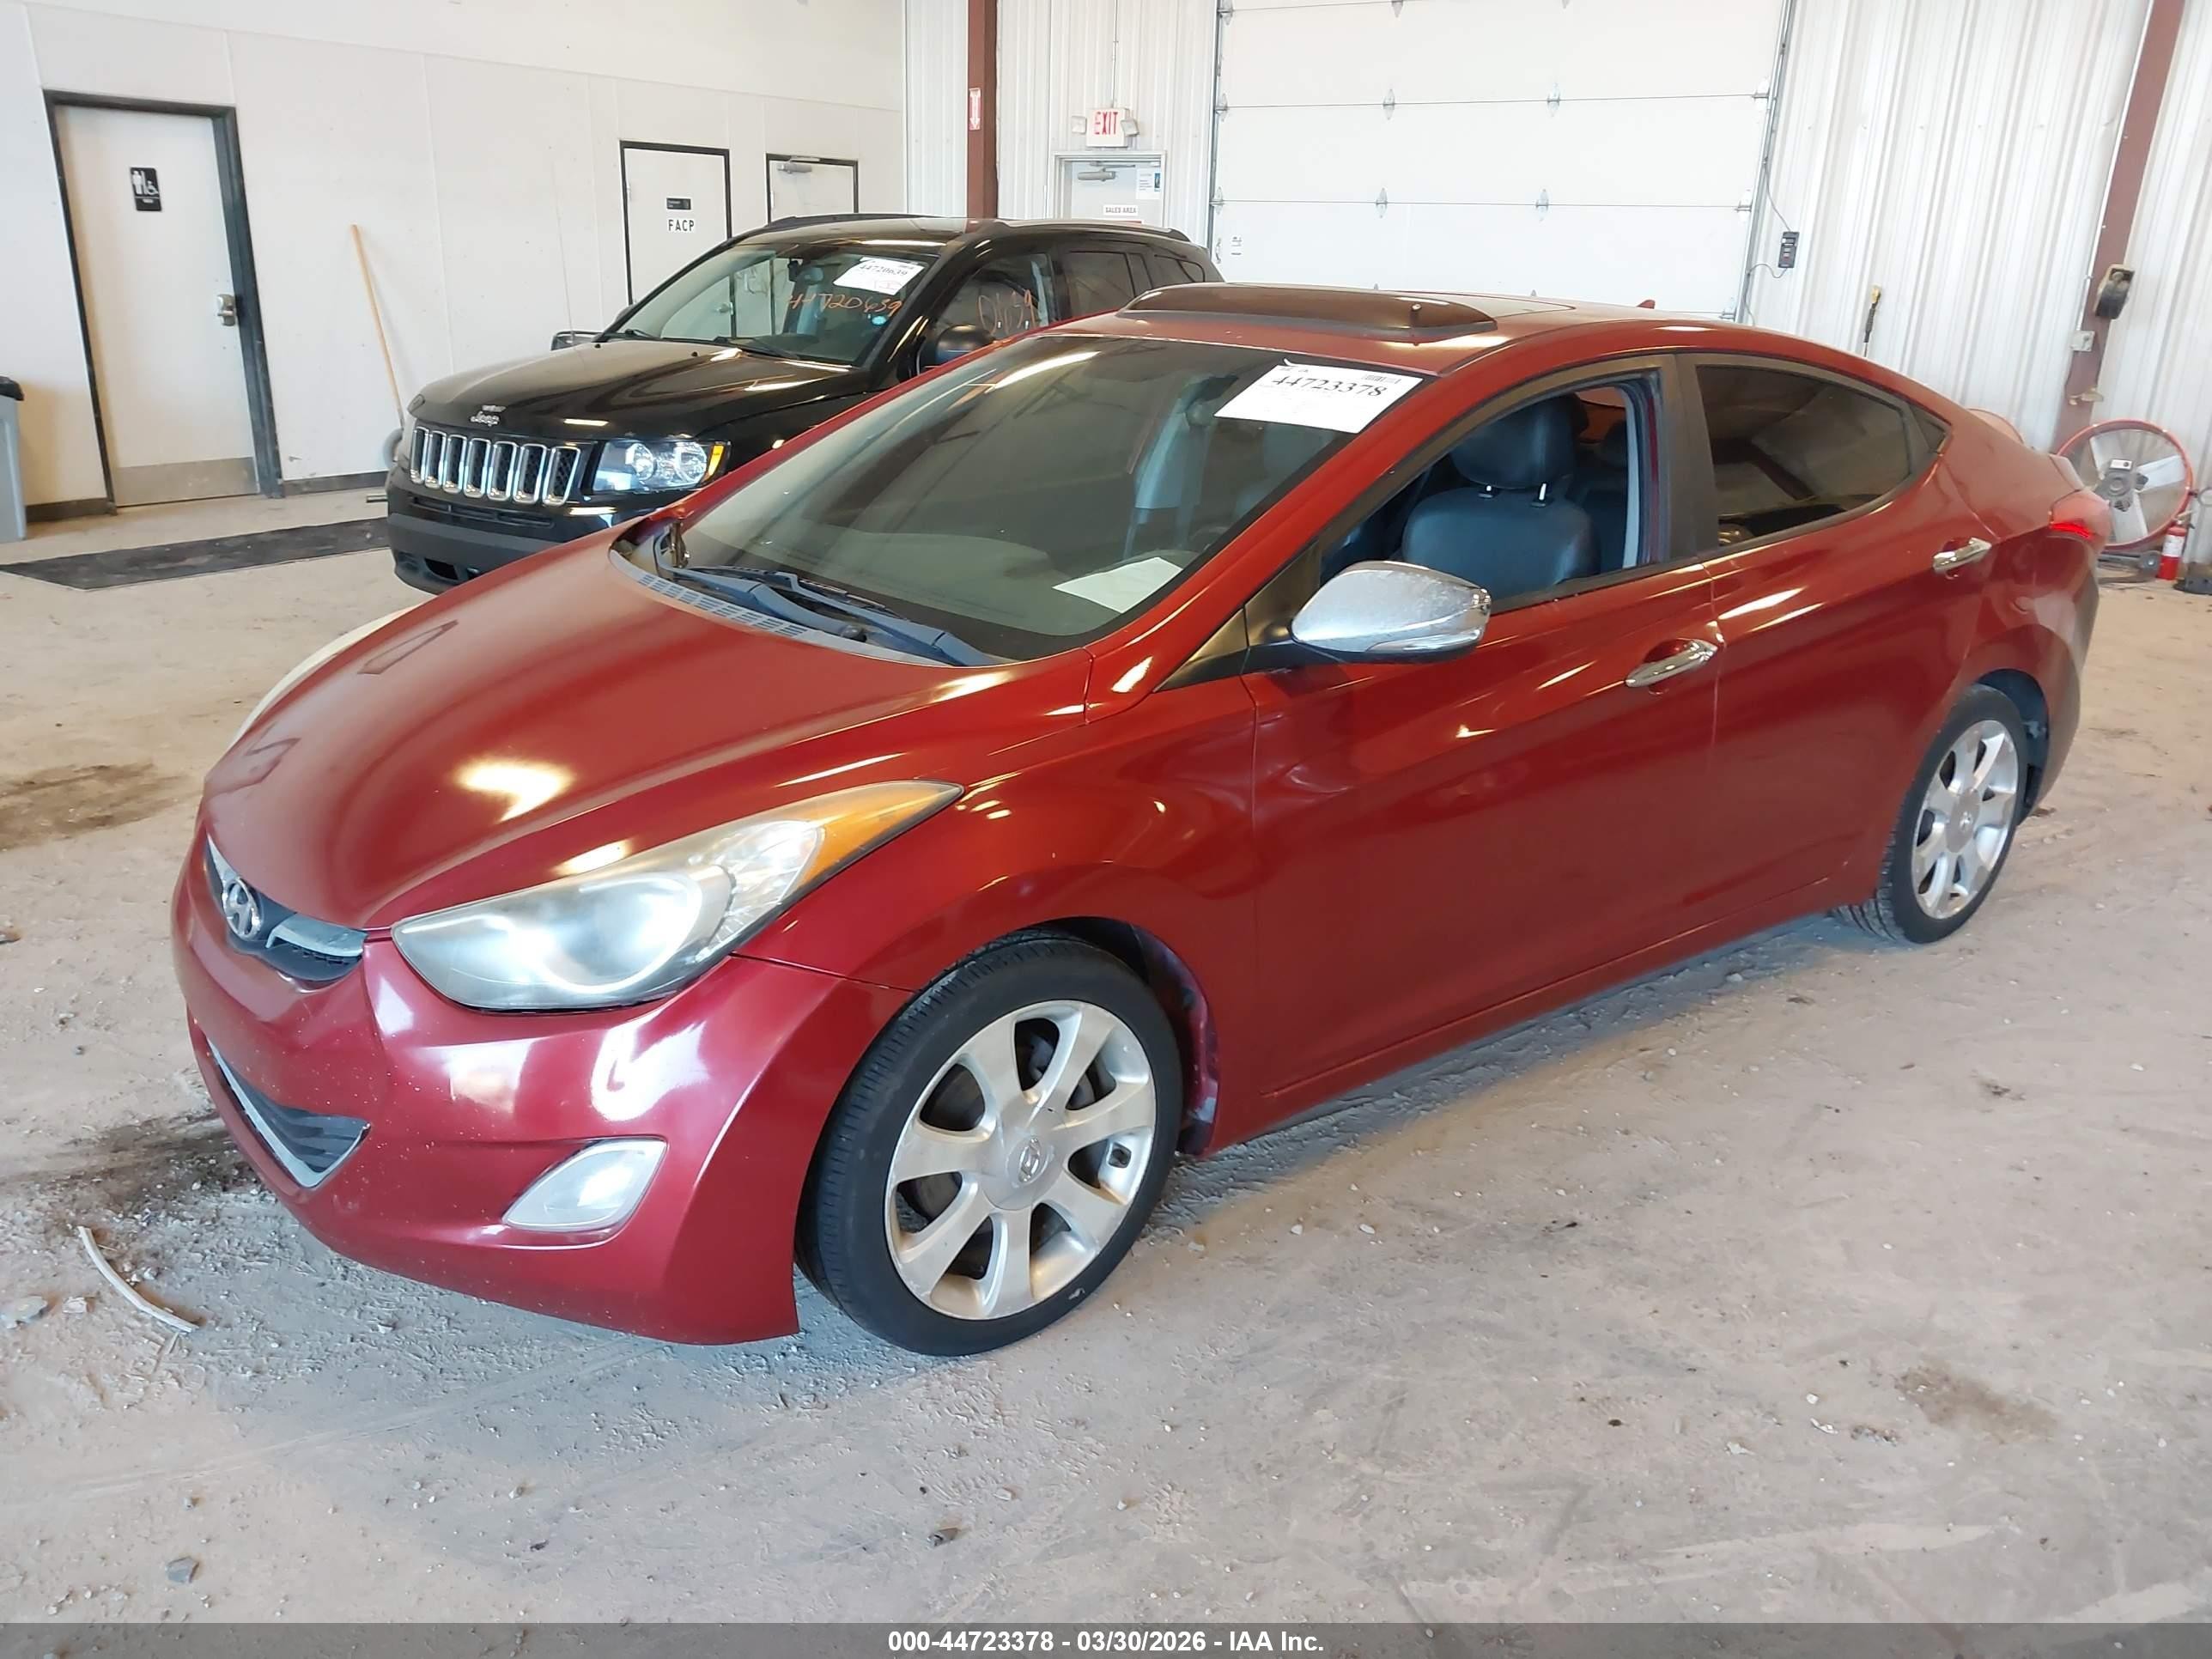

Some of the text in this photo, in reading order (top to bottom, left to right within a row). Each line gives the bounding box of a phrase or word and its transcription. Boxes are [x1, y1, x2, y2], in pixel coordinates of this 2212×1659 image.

[1094, 112, 1119, 135] EXIT
[668, 219, 695, 232] FACP
[1272, 375, 1388, 397] 44723378
[470, 410, 500, 427] Jeep
